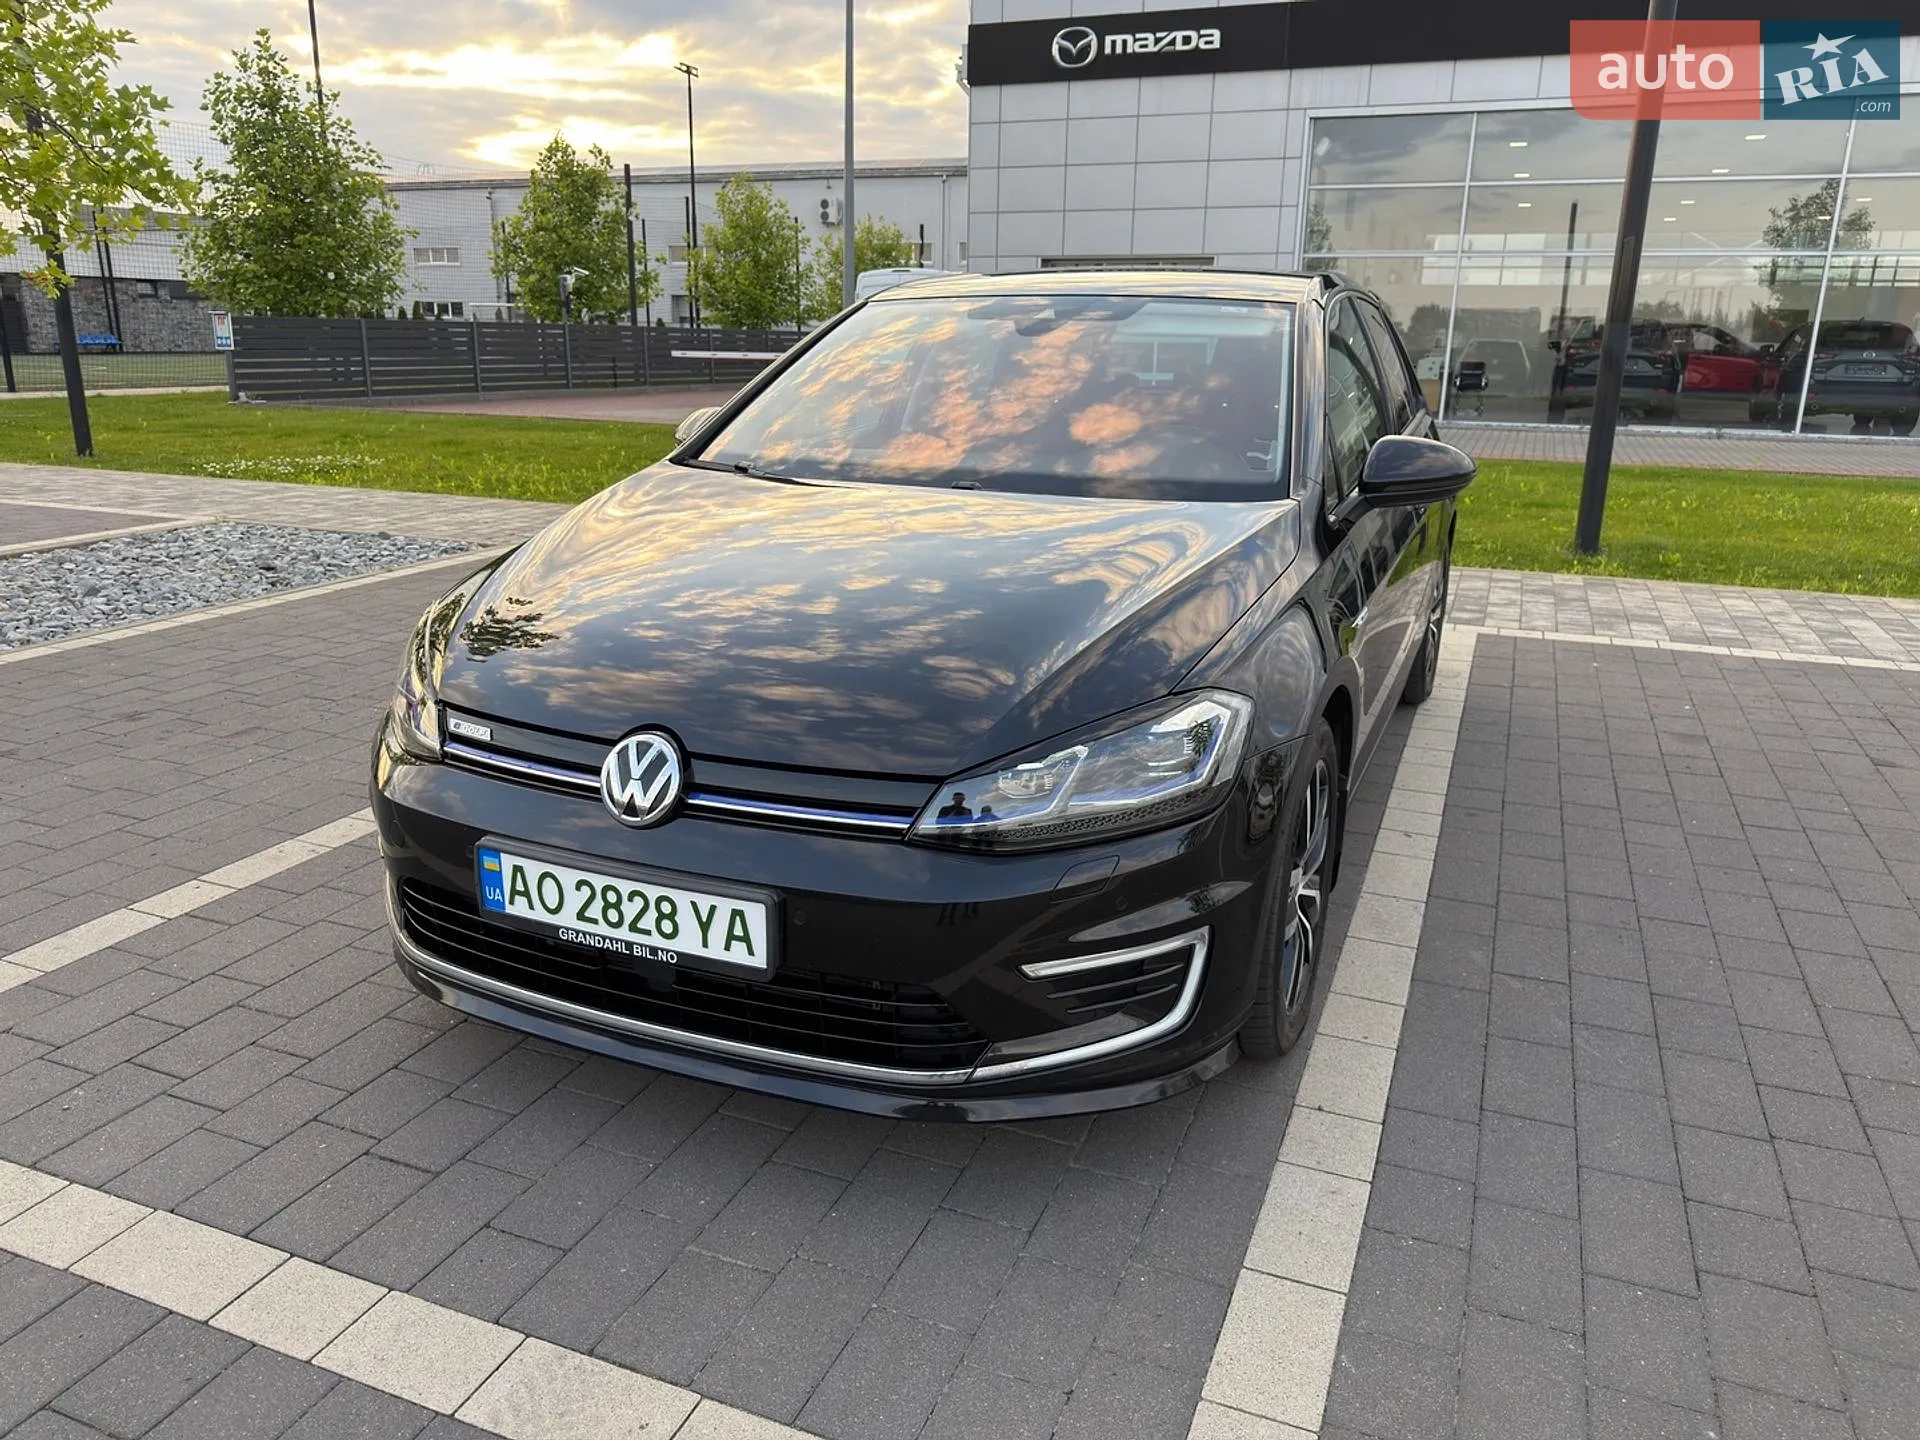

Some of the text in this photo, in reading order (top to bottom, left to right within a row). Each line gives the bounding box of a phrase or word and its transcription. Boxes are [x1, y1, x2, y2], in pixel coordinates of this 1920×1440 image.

[485, 886, 503, 902] UA
[508, 864, 756, 957] AO 2828 YA
[559, 928, 679, 964] GRANDAHL BIL.NO
